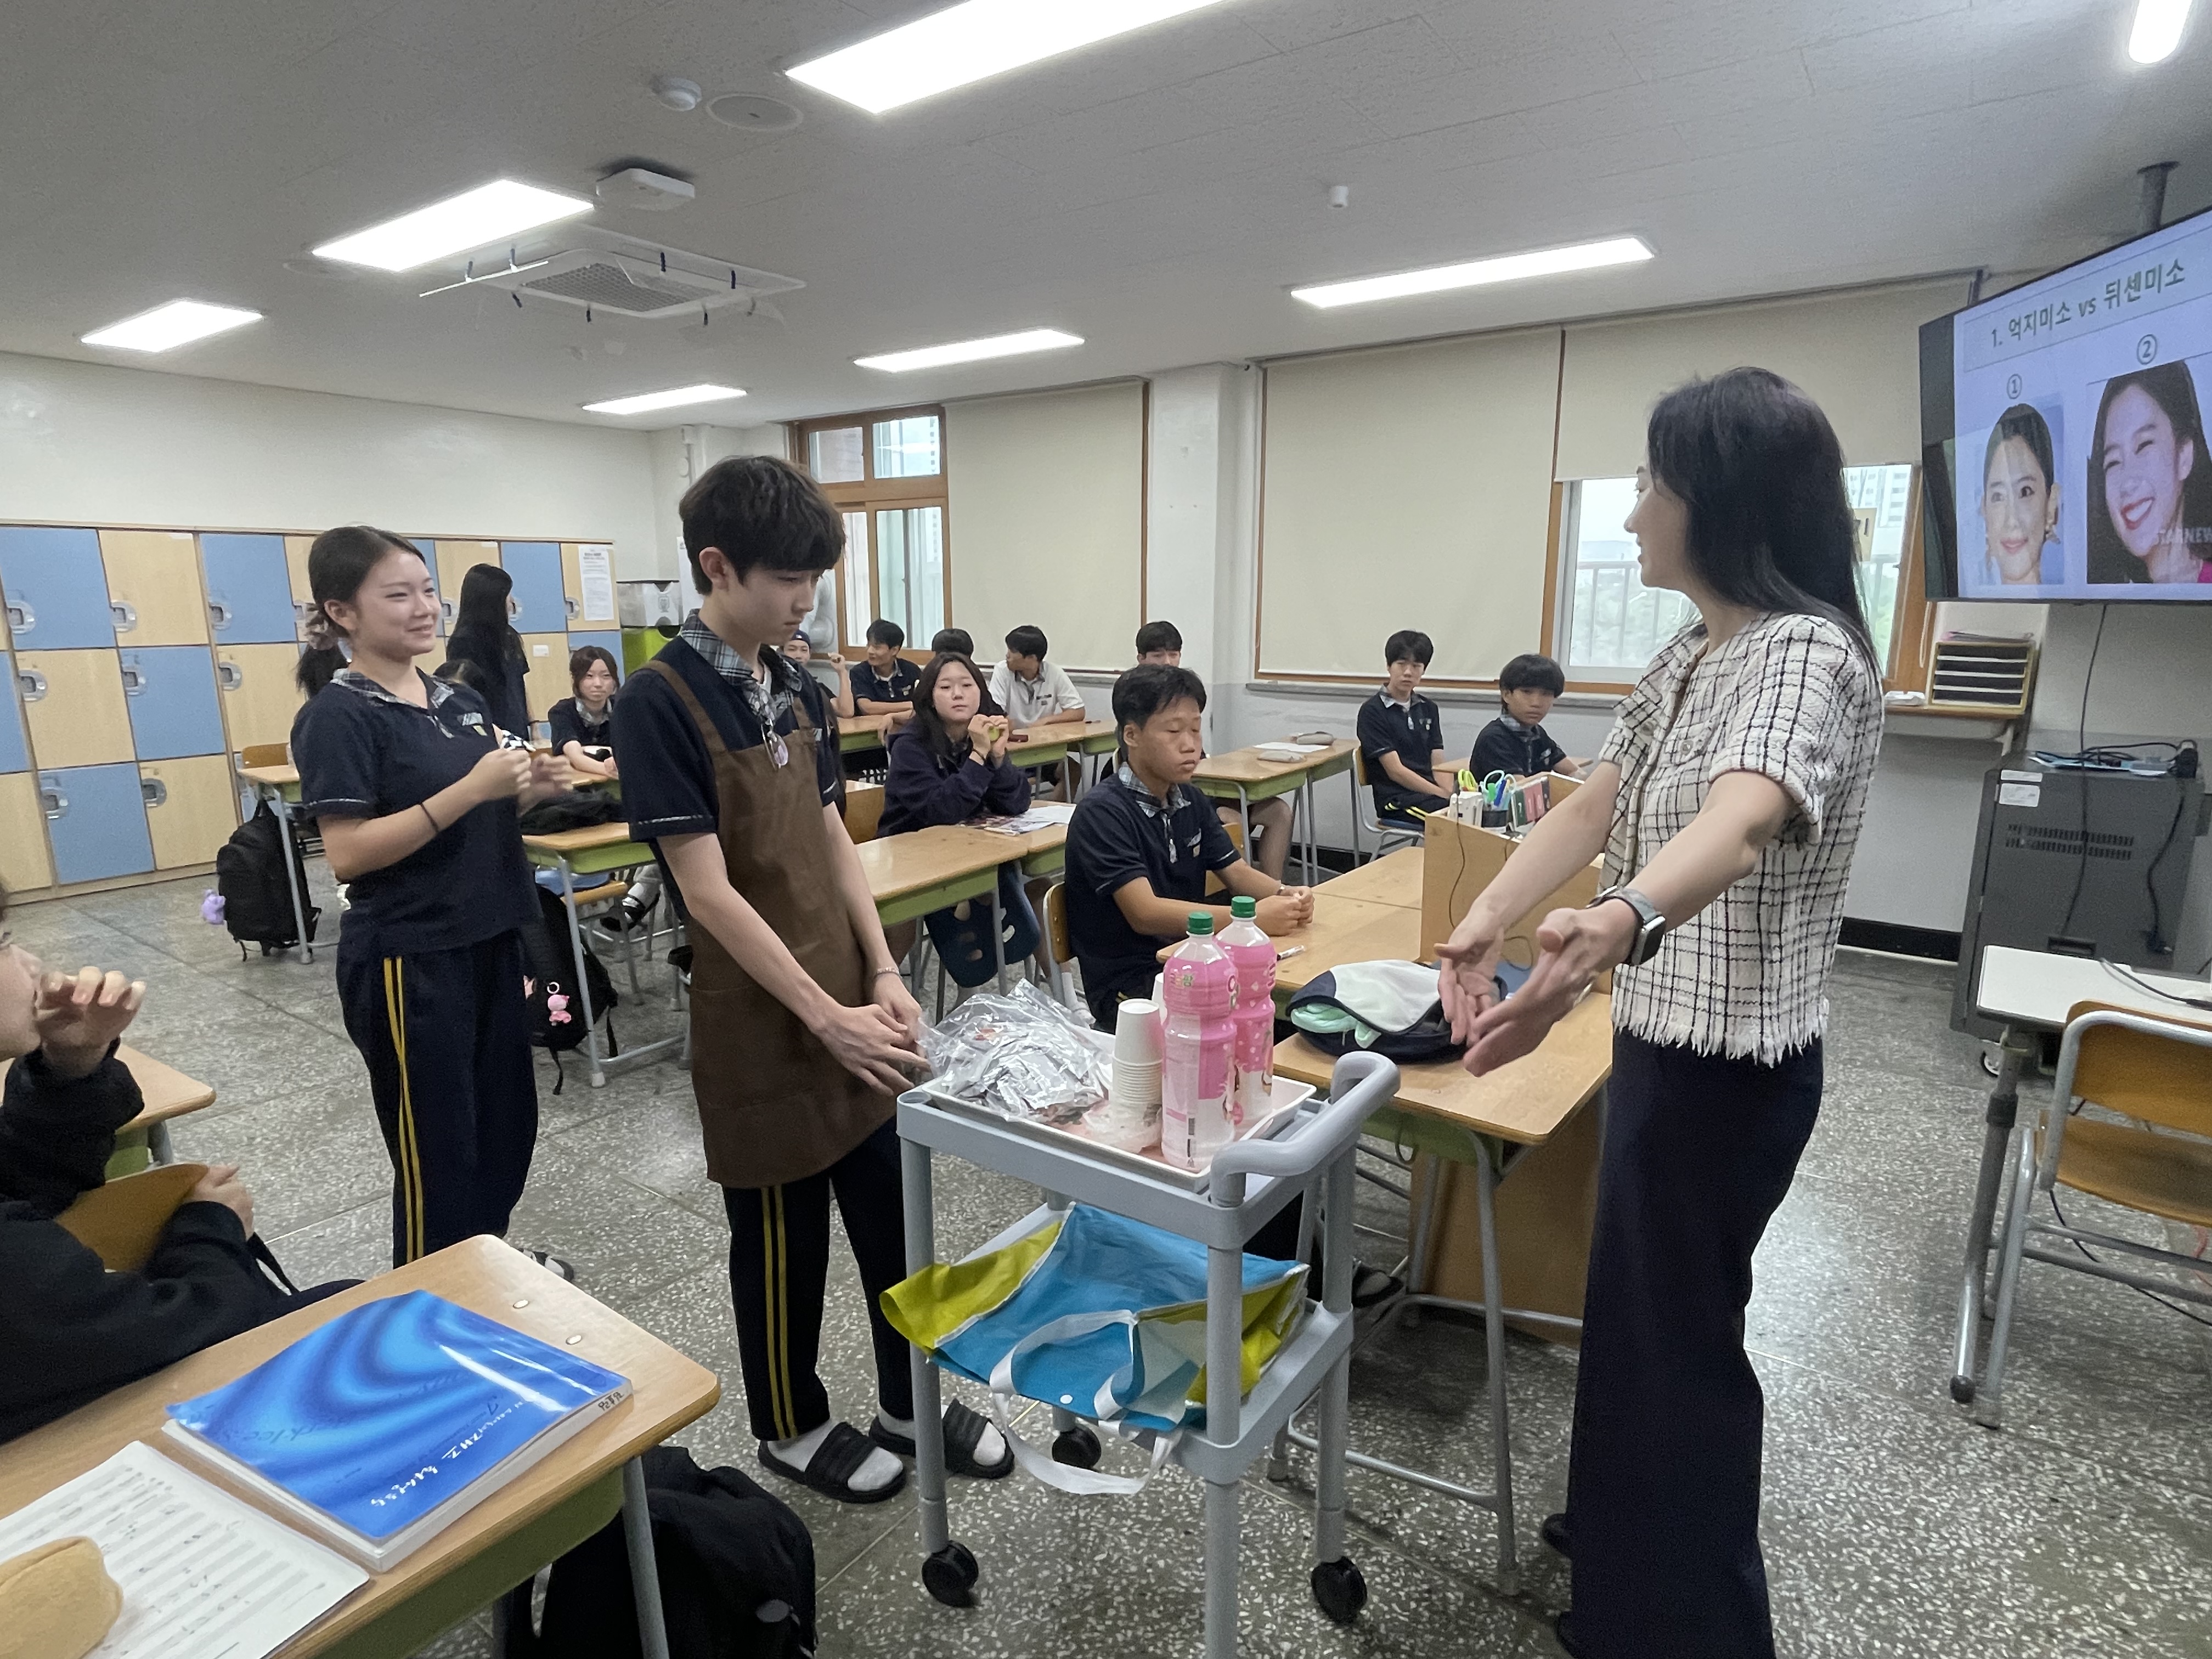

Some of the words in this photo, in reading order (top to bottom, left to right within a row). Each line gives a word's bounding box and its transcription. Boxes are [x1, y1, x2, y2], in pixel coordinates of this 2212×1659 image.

[1991, 329, 2003, 347] 1.
[2008, 301, 2072, 341] 억지미소
[2078, 297, 2096, 317] vs
[2103, 258, 2186, 309] 뒤센미소
